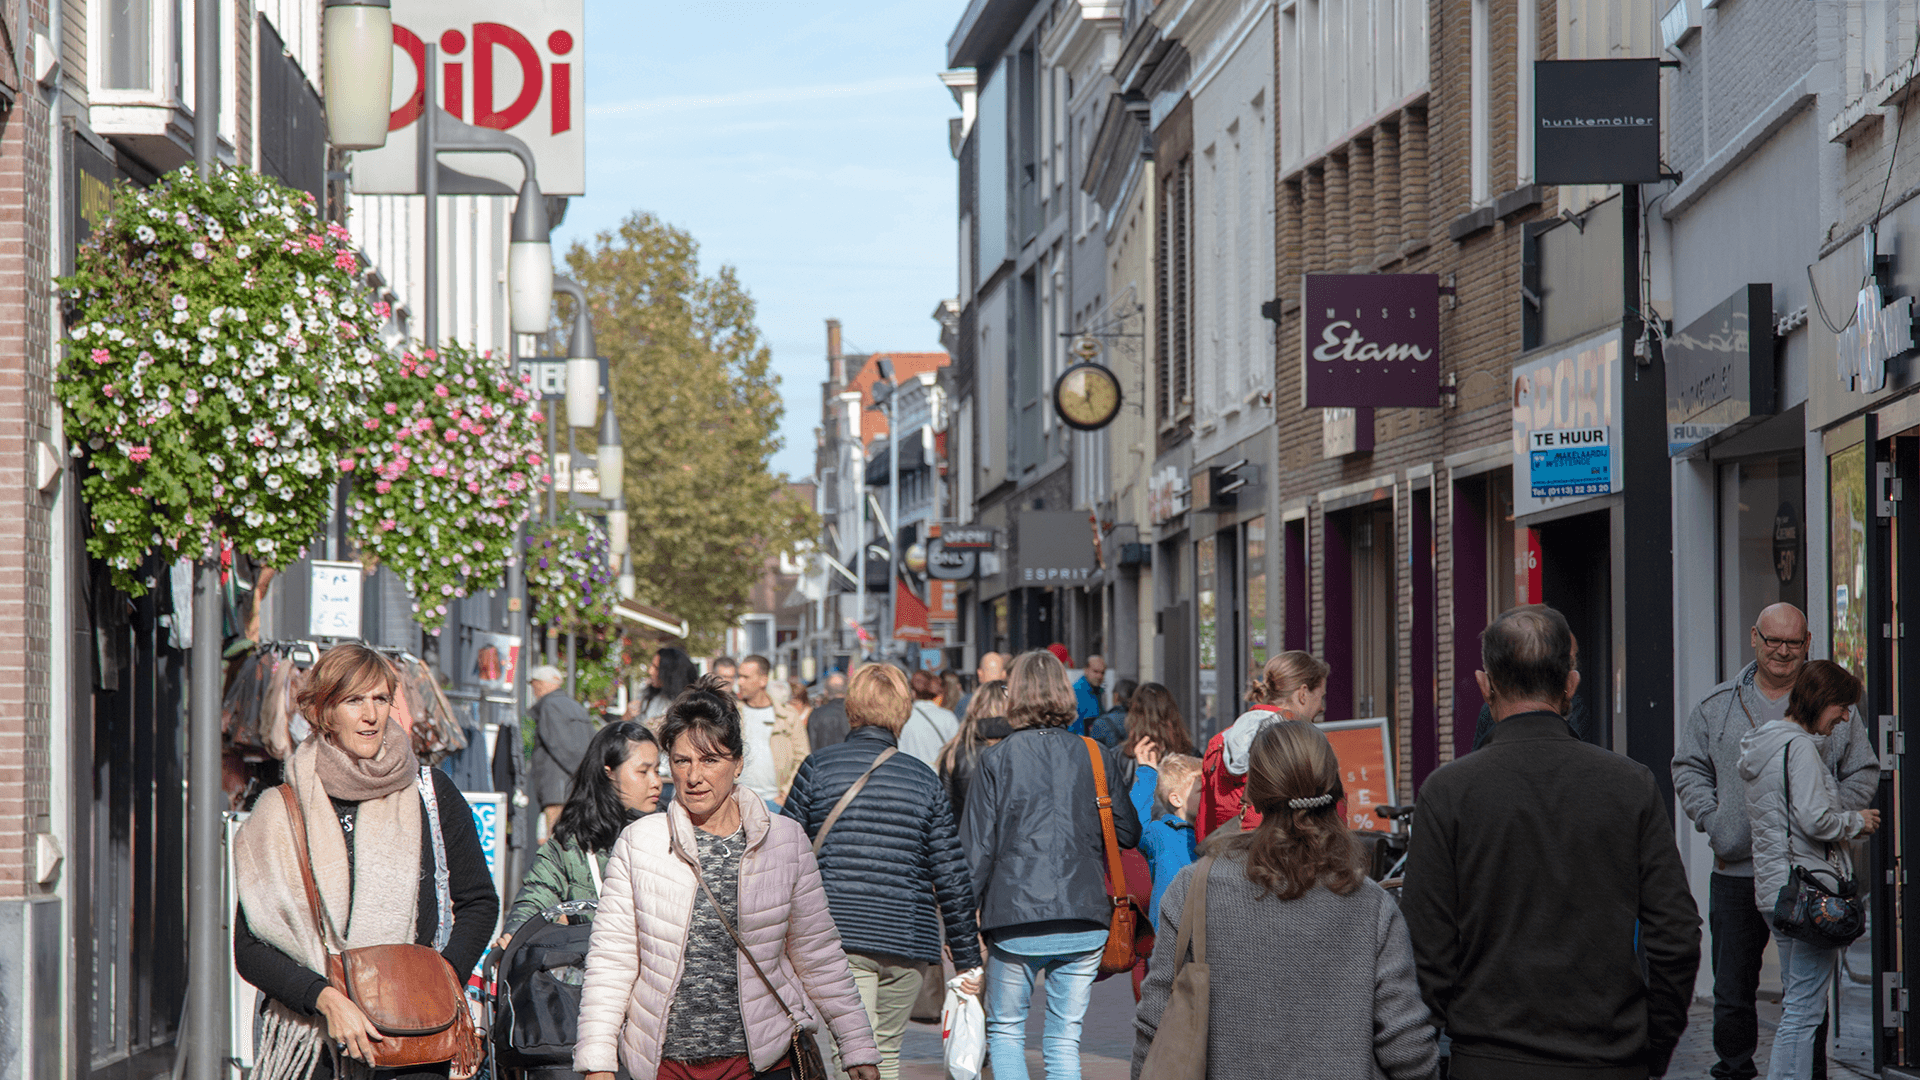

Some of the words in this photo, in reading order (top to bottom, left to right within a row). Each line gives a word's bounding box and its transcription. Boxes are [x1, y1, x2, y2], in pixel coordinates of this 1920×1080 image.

[1326, 307, 1416, 319] MISS
[1312, 320, 1433, 362] Etam
[1513, 339, 1618, 456] SPORT
[1534, 433, 1554, 446] TE
[1559, 430, 1603, 444] HUUR
[1532, 487, 1546, 496] Tel.
[1024, 567, 1089, 581] ESPRIT
